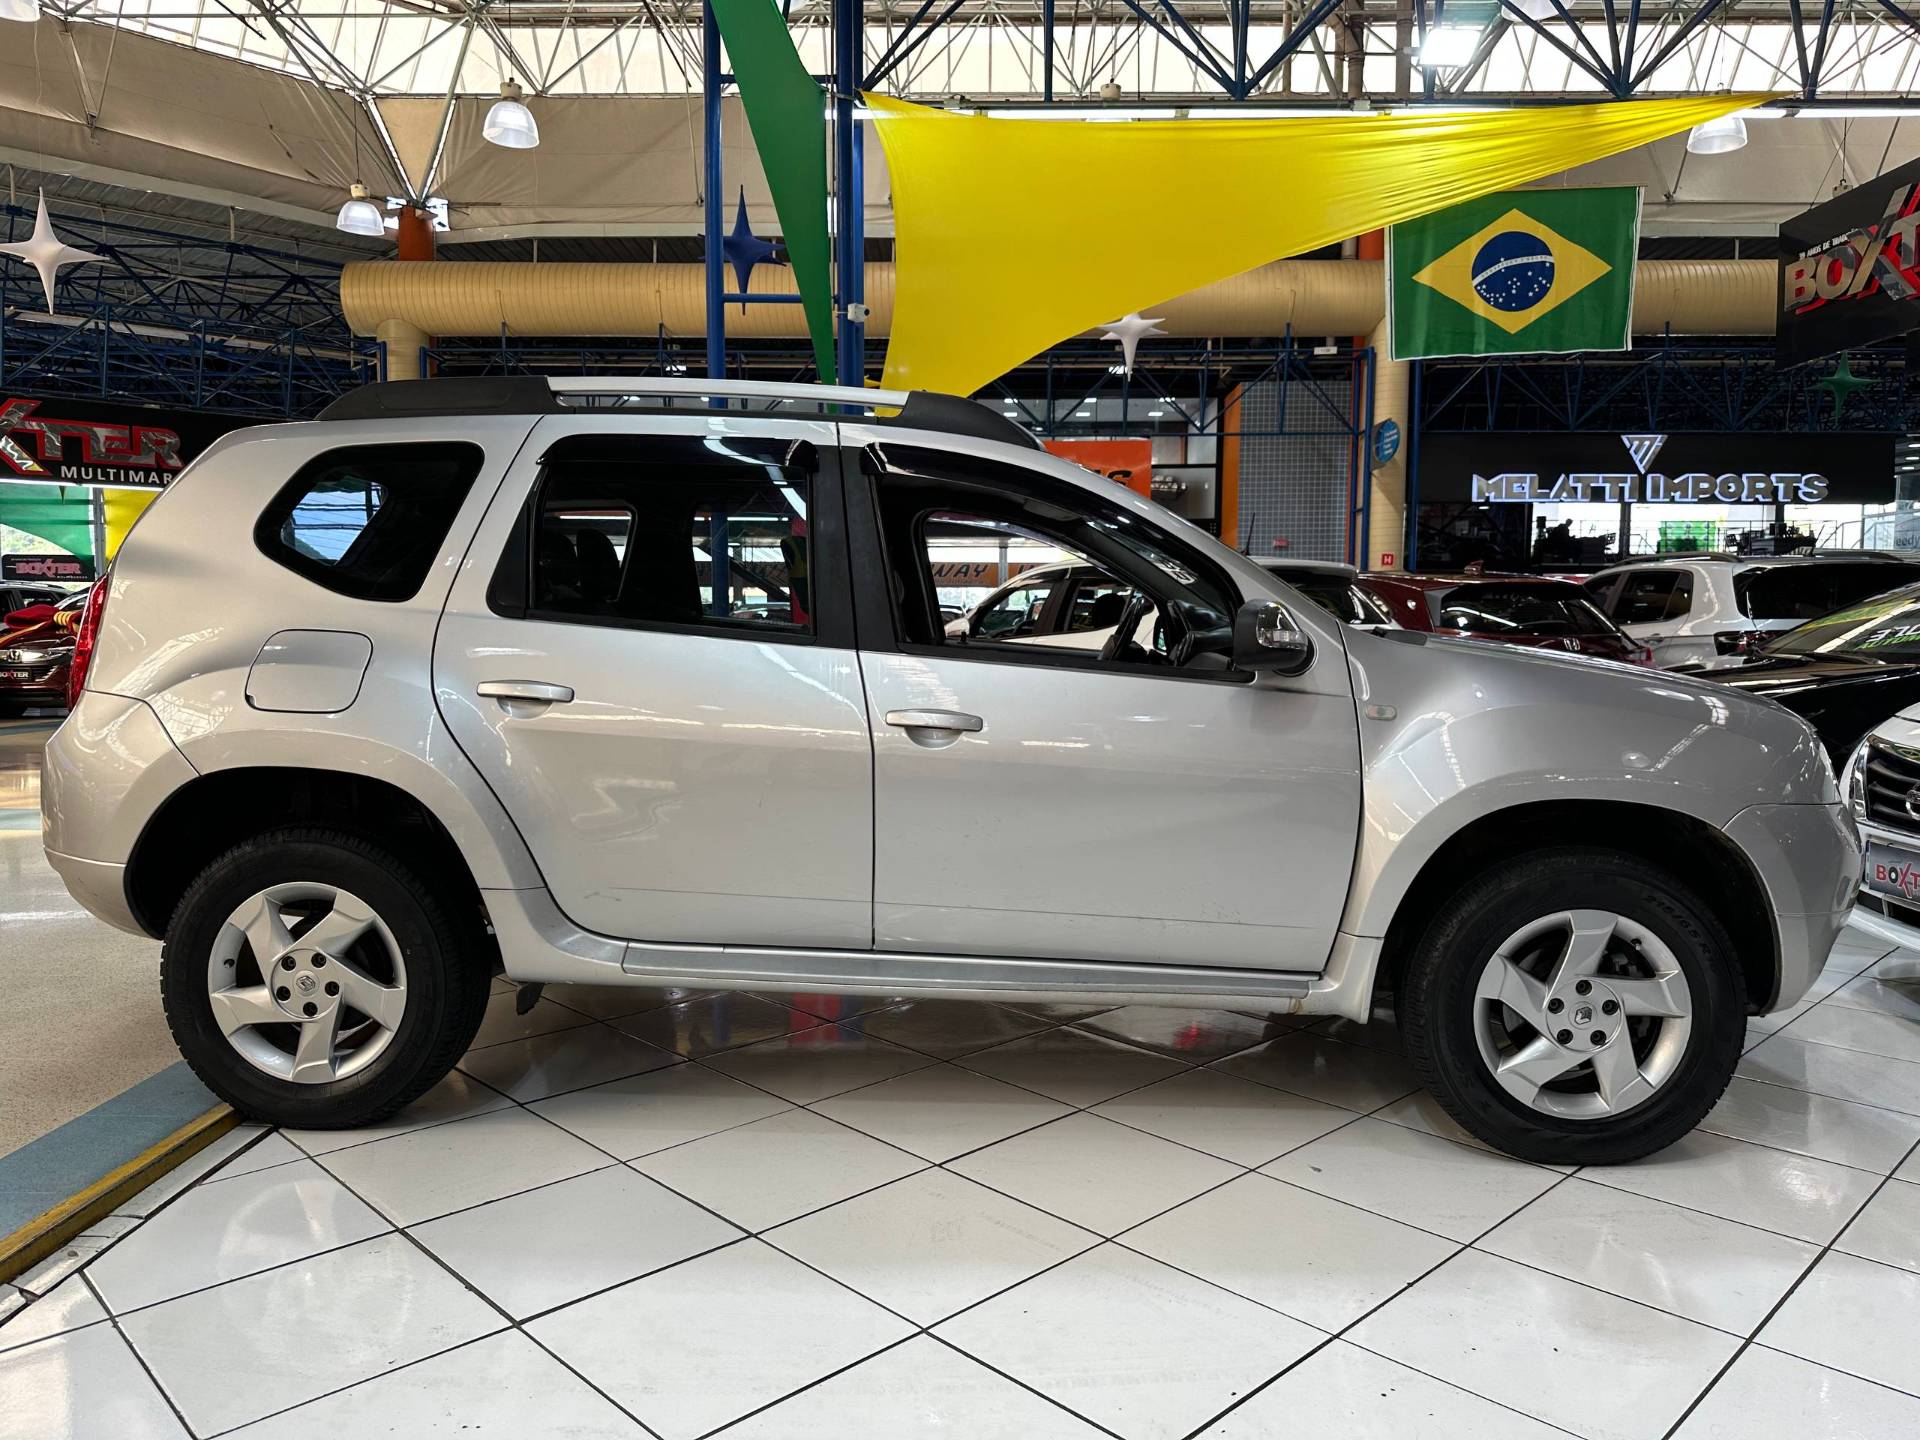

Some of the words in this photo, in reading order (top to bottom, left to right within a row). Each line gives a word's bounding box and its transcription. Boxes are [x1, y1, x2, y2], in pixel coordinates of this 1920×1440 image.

[1471, 473, 1639, 503] MELATTI
[1646, 473, 1830, 503] IMPORTS
[16, 558, 82, 578] BOXTER
[0, 669, 29, 680] OXTER
